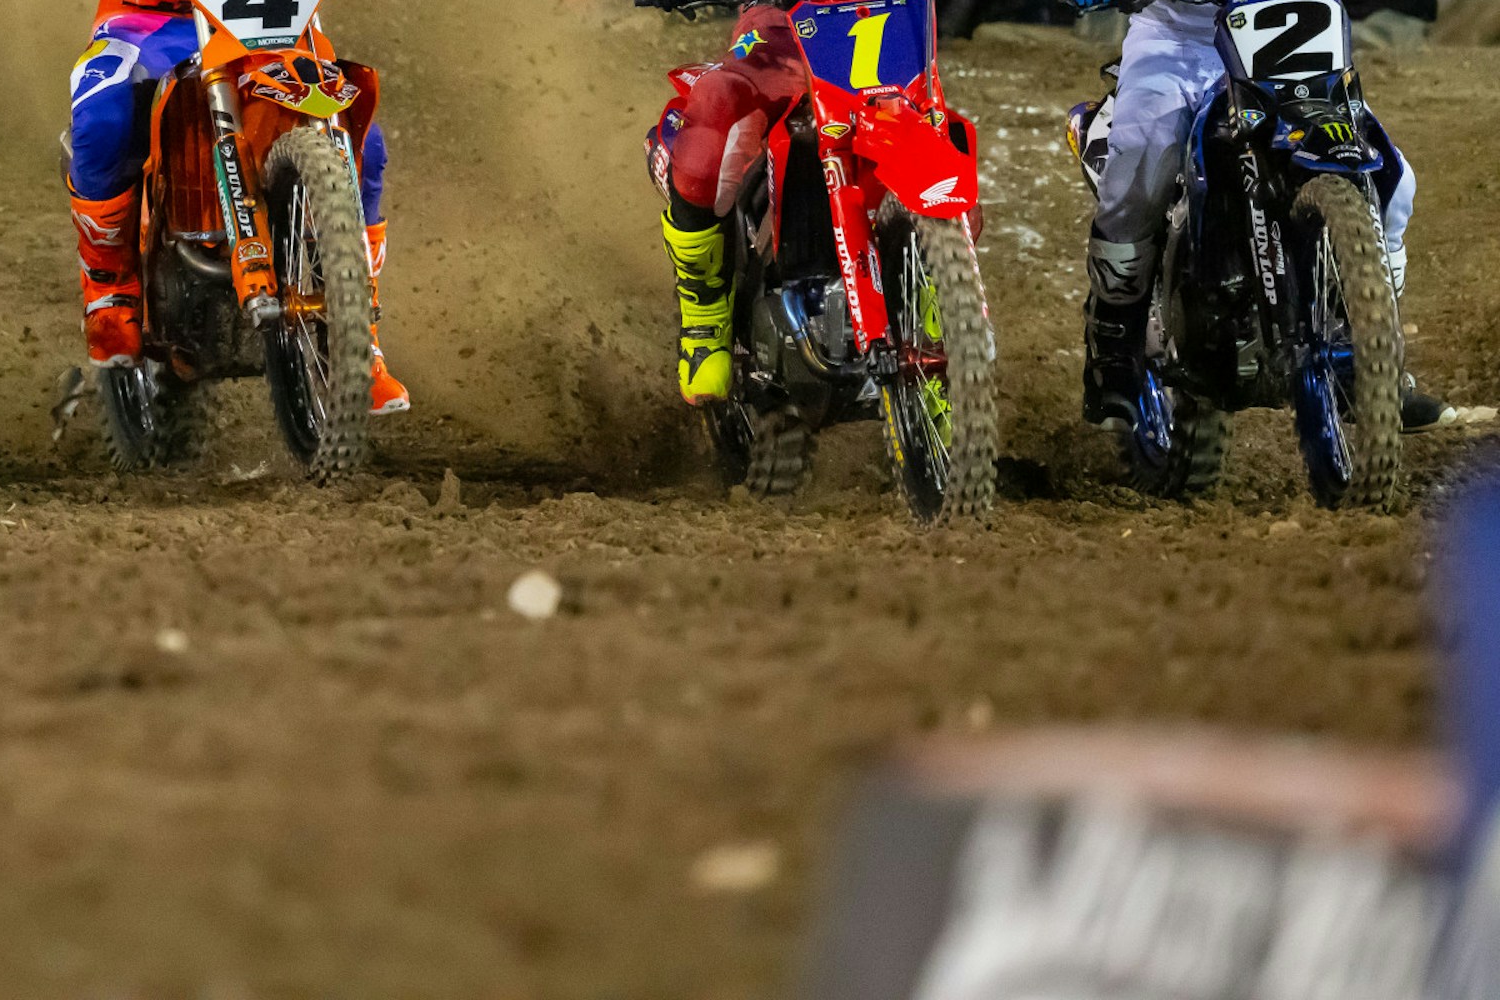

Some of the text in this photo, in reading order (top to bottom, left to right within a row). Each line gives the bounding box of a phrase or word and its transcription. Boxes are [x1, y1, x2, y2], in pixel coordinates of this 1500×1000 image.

[257, 37, 295, 46] MOTOREX
[847, 12, 891, 89] 1
[1252, 1, 1333, 81] 2
[862, 85, 899, 95] HONDA
[225, 160, 254, 238] DUNLOP
[922, 196, 968, 209] HONDA
[833, 226, 862, 325] DUNLOP
[1253, 208, 1278, 305] DUNLOP
